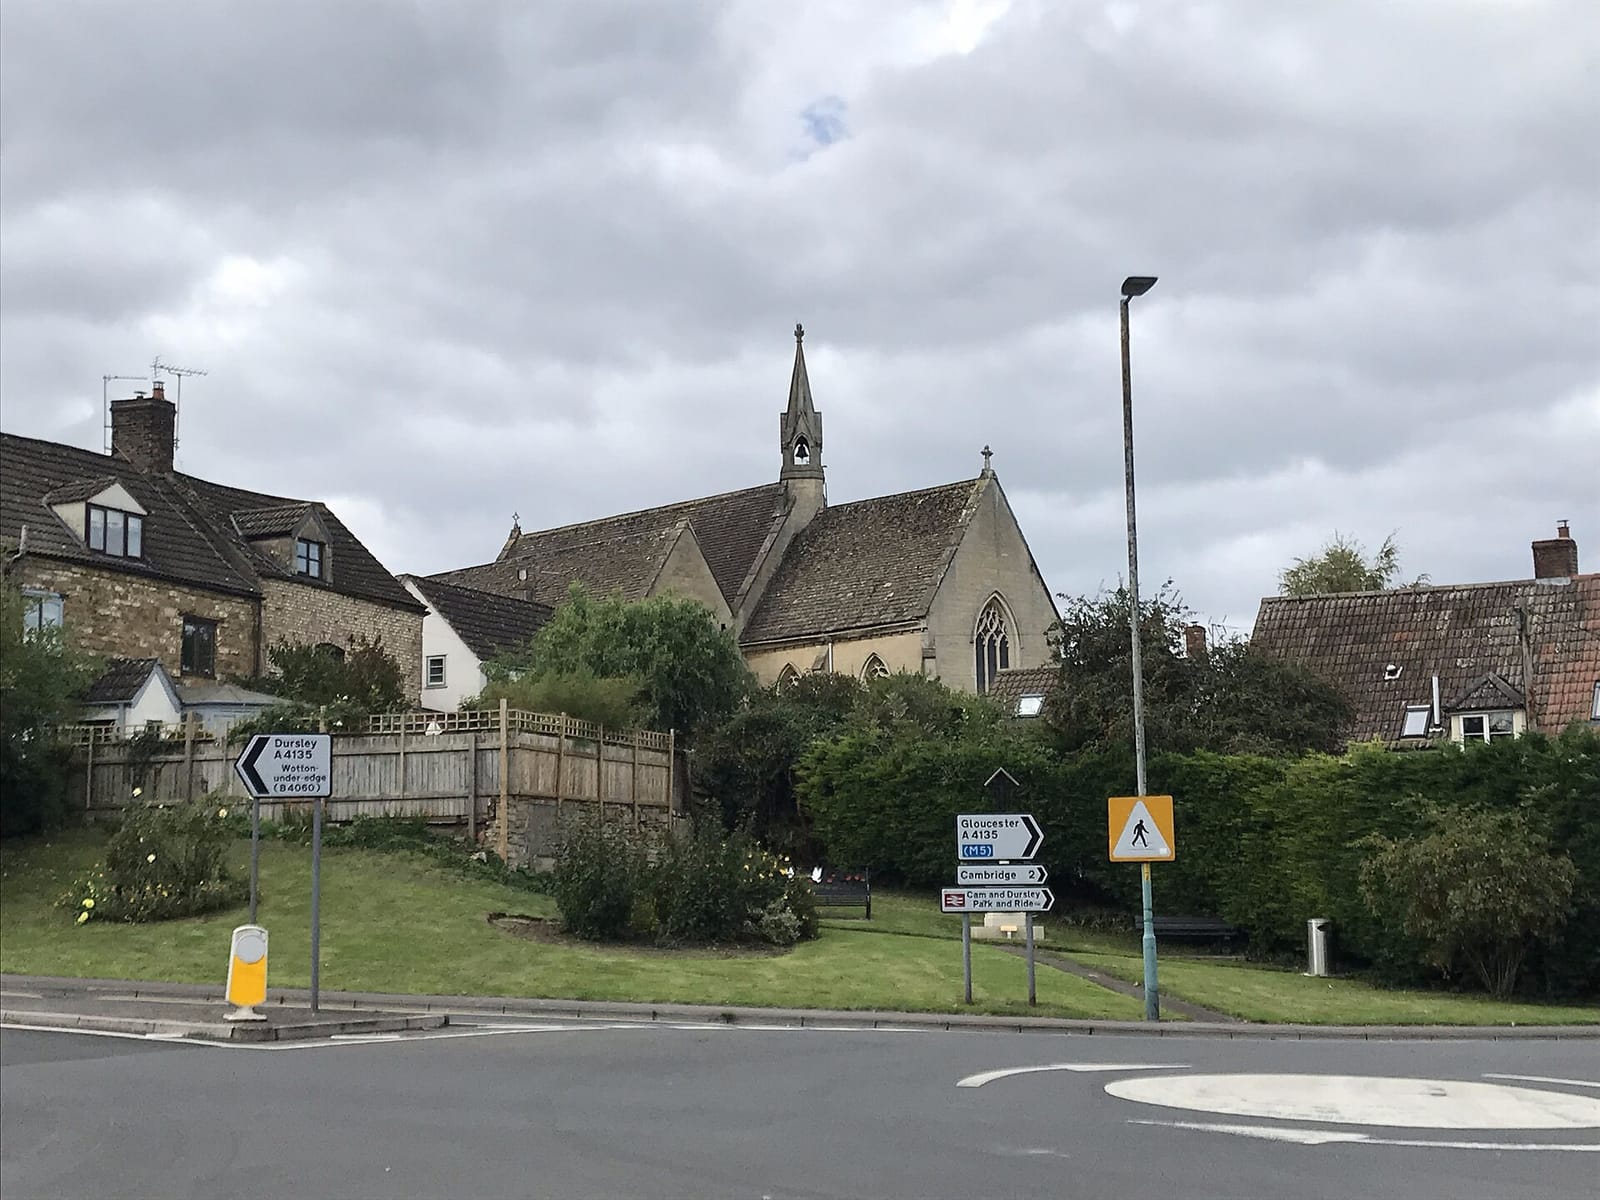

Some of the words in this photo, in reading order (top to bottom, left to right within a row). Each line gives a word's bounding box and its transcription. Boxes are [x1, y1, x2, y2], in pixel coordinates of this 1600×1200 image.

[275, 739, 317, 749] Dursley
[282, 764, 318, 772] Wotton-
[274, 774, 326, 782] under-edge
[961, 819, 1020, 828] Gloucester
[964, 846, 992, 856] (M5)
[960, 870, 1016, 880] Cambridge
[1028, 870, 1035, 879] 2
[1007, 891, 1040, 900] Dursley
